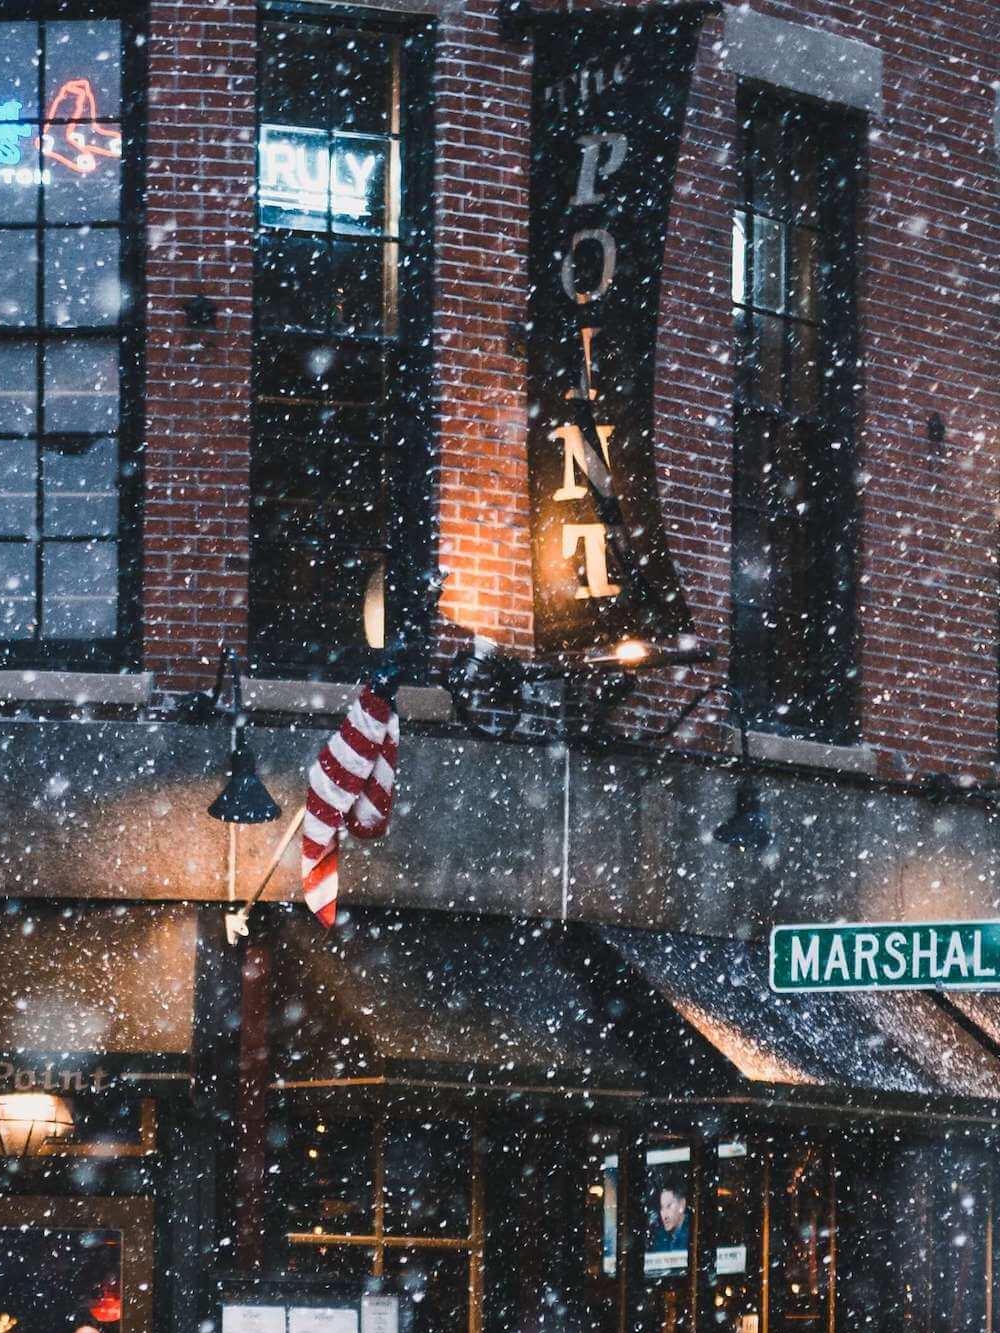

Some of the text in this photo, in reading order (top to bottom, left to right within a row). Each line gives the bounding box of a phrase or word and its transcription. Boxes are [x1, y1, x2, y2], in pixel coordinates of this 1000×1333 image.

[259, 141, 377, 199] RULY
[553, 132, 629, 600] POINT
[791, 930, 996, 982] MARSHAL
